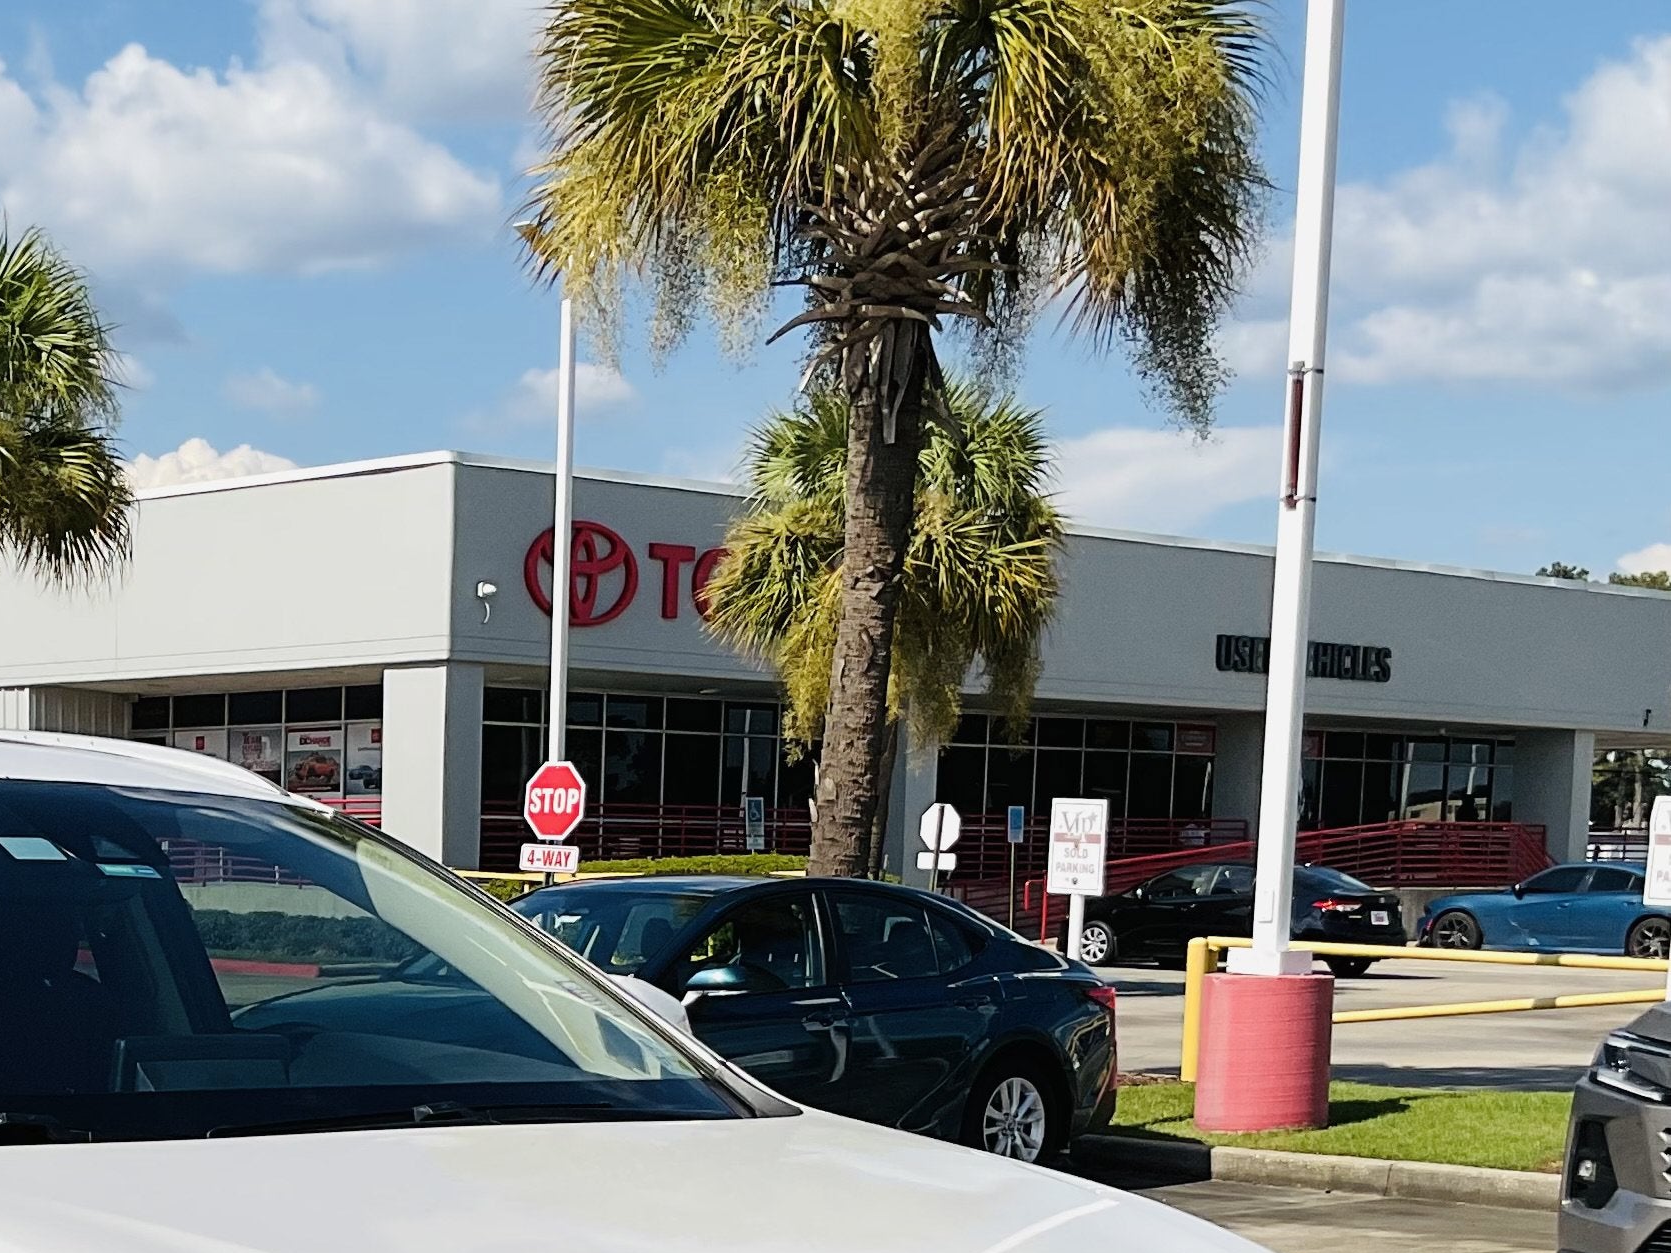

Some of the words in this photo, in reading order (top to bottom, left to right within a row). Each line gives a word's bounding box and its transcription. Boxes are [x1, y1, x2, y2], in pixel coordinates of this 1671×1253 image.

[1215, 634, 1271, 673] USE
[1307, 640, 1392, 682] EHICLES
[529, 787, 580, 814] STOP
[527, 849, 571, 868] 4-WAY
[1064, 847, 1089, 859] SOLD
[1056, 861, 1095, 875] PARKING
